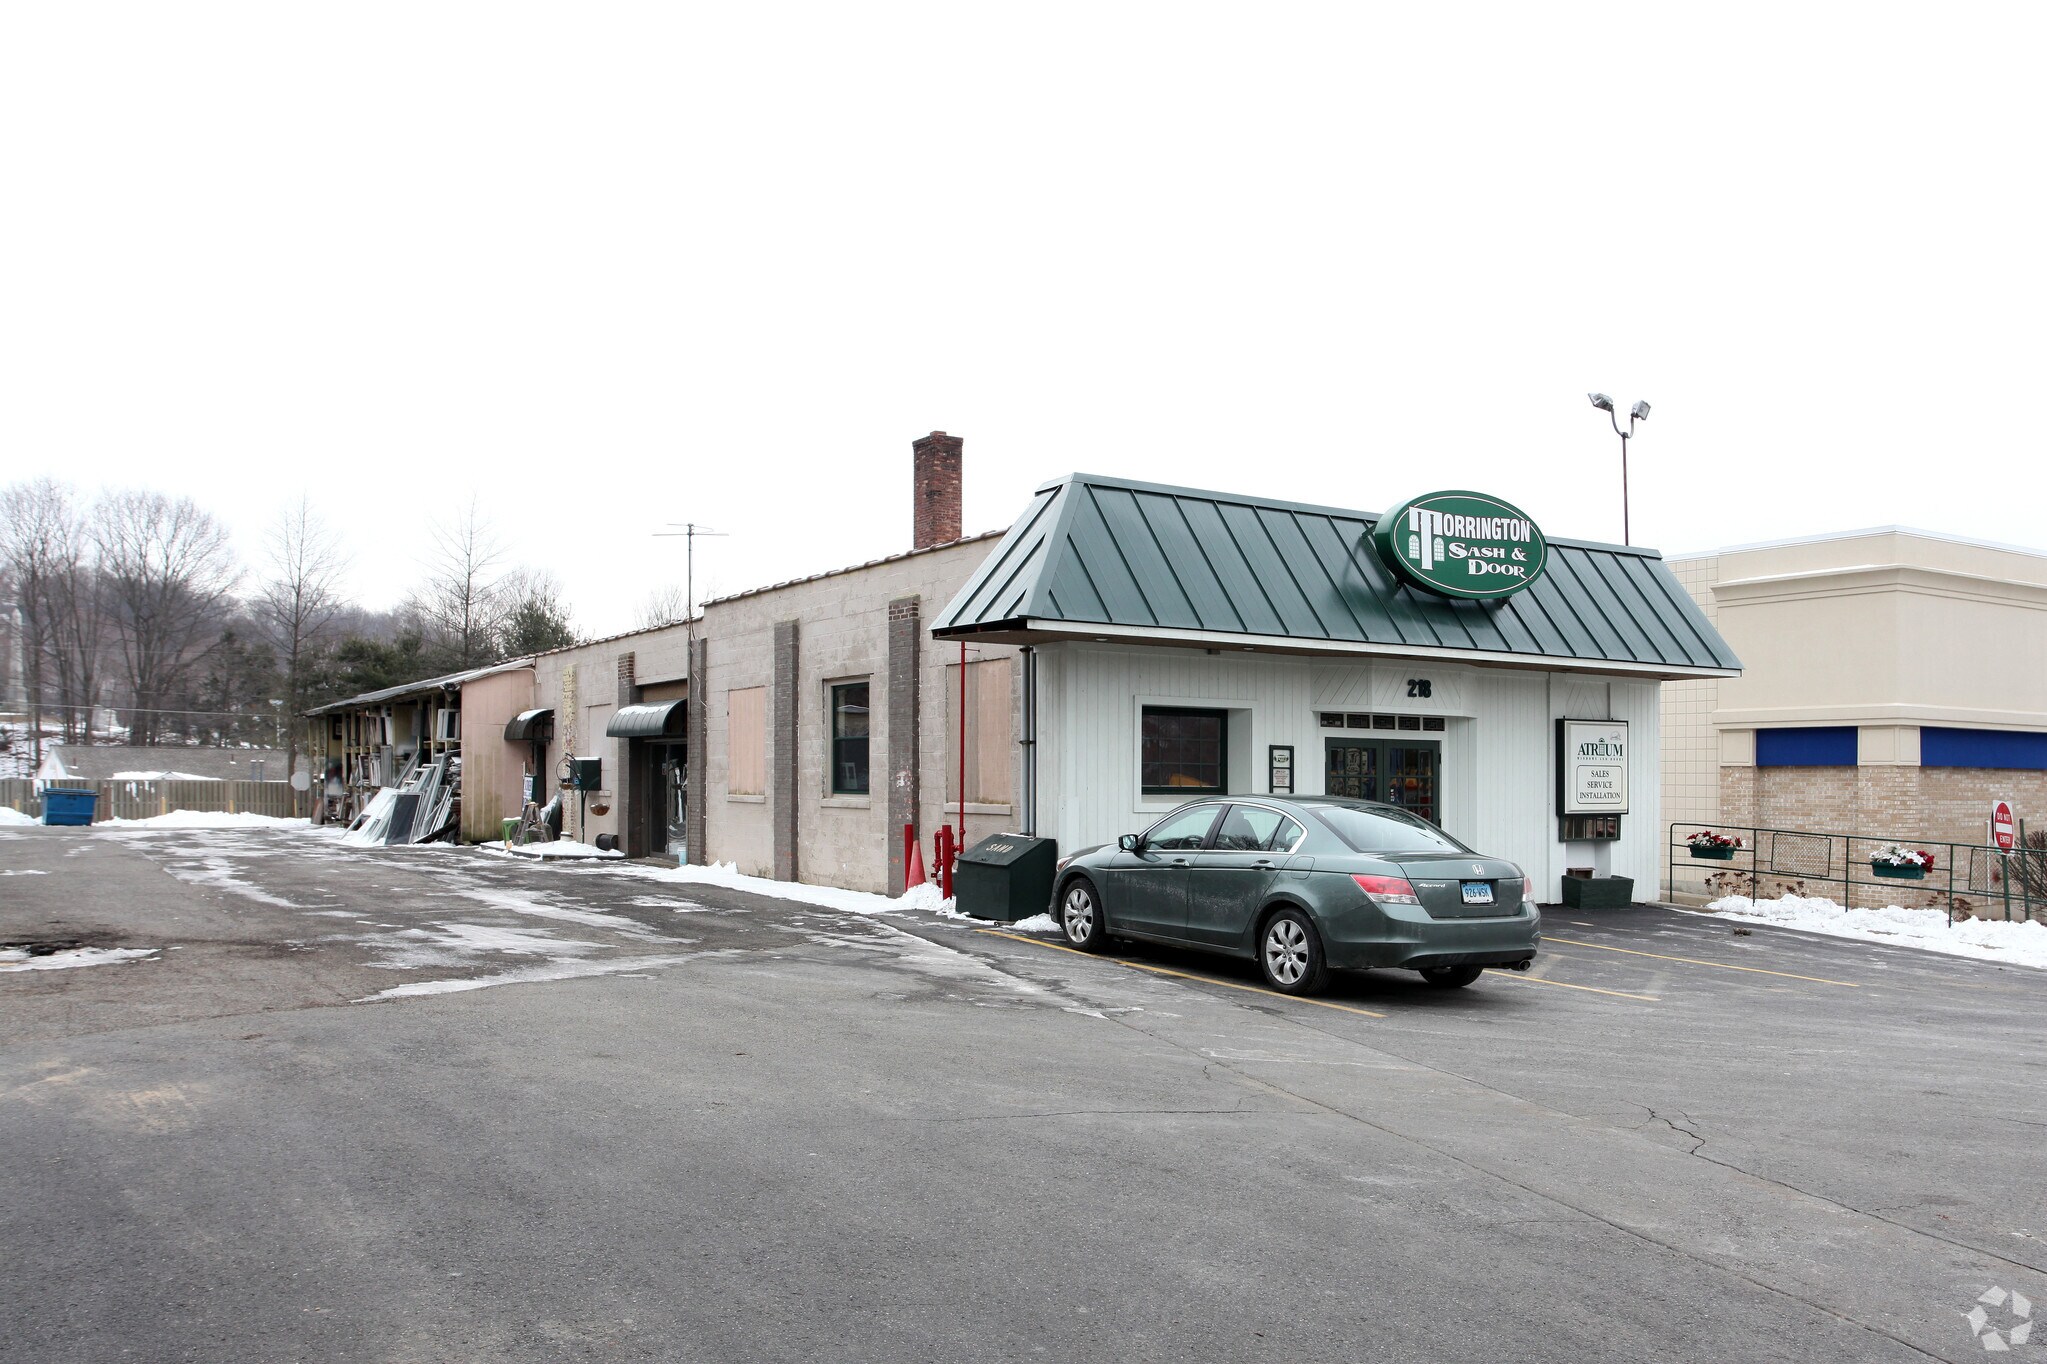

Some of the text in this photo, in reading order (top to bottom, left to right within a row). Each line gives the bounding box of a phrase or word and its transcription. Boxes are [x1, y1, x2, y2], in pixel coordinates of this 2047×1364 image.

[1511, 547, 1527, 562] &
[1407, 679, 1431, 698] 218
[1578, 743, 1623, 757] ATRIUM
[1997, 812, 2003, 820] DO
[2000, 835, 2010, 843] ENTER
